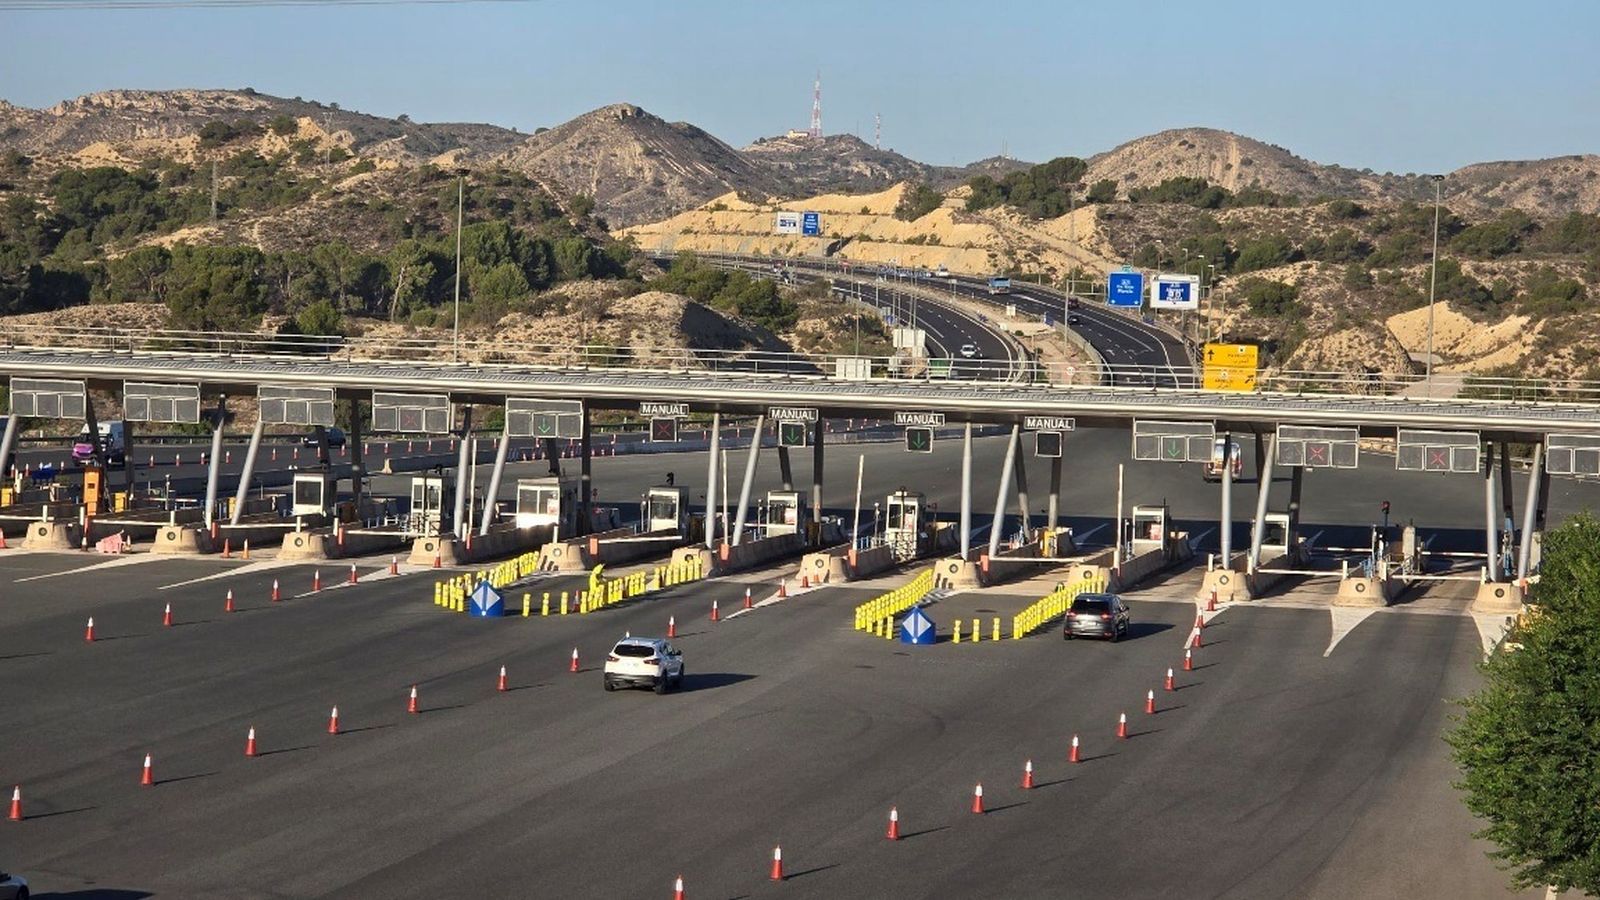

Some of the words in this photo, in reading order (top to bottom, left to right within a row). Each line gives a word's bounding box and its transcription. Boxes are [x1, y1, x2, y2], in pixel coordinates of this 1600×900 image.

[642, 404, 686, 415] MANUAL
[771, 409, 815, 420] MANUAL
[897, 414, 942, 425] MANUAL
[1026, 418, 1072, 429] MANUAL
